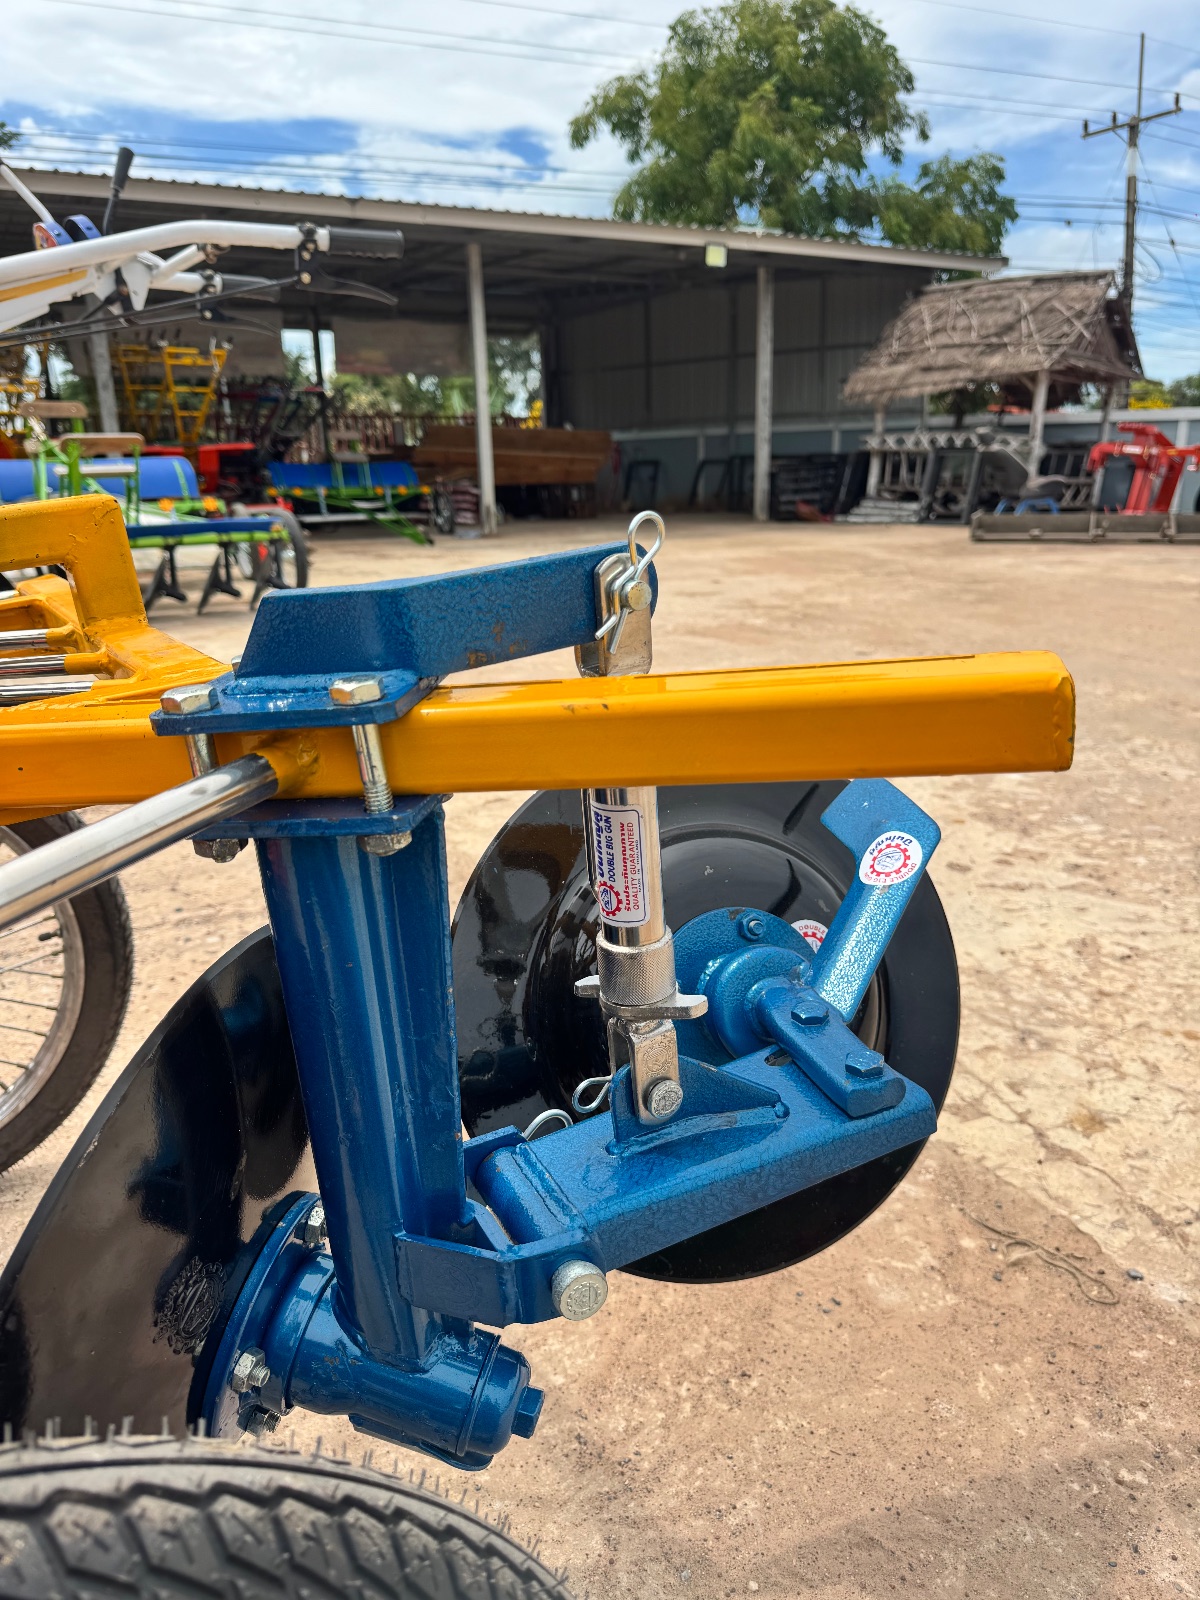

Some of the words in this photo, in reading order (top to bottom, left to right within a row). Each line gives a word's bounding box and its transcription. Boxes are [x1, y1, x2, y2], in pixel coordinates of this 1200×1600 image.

[603, 815, 612, 834] GUN
[604, 835, 614, 851] BIG
[626, 821, 637, 875] GUARANTEED
[606, 850, 616, 883] DOUBLE
[620, 821, 631, 912] รับประกันคุณภาพ
[889, 862, 917, 883] DOUBLE
[630, 876, 640, 911] QUALITY
[798, 923, 826, 935] DOUBLE
